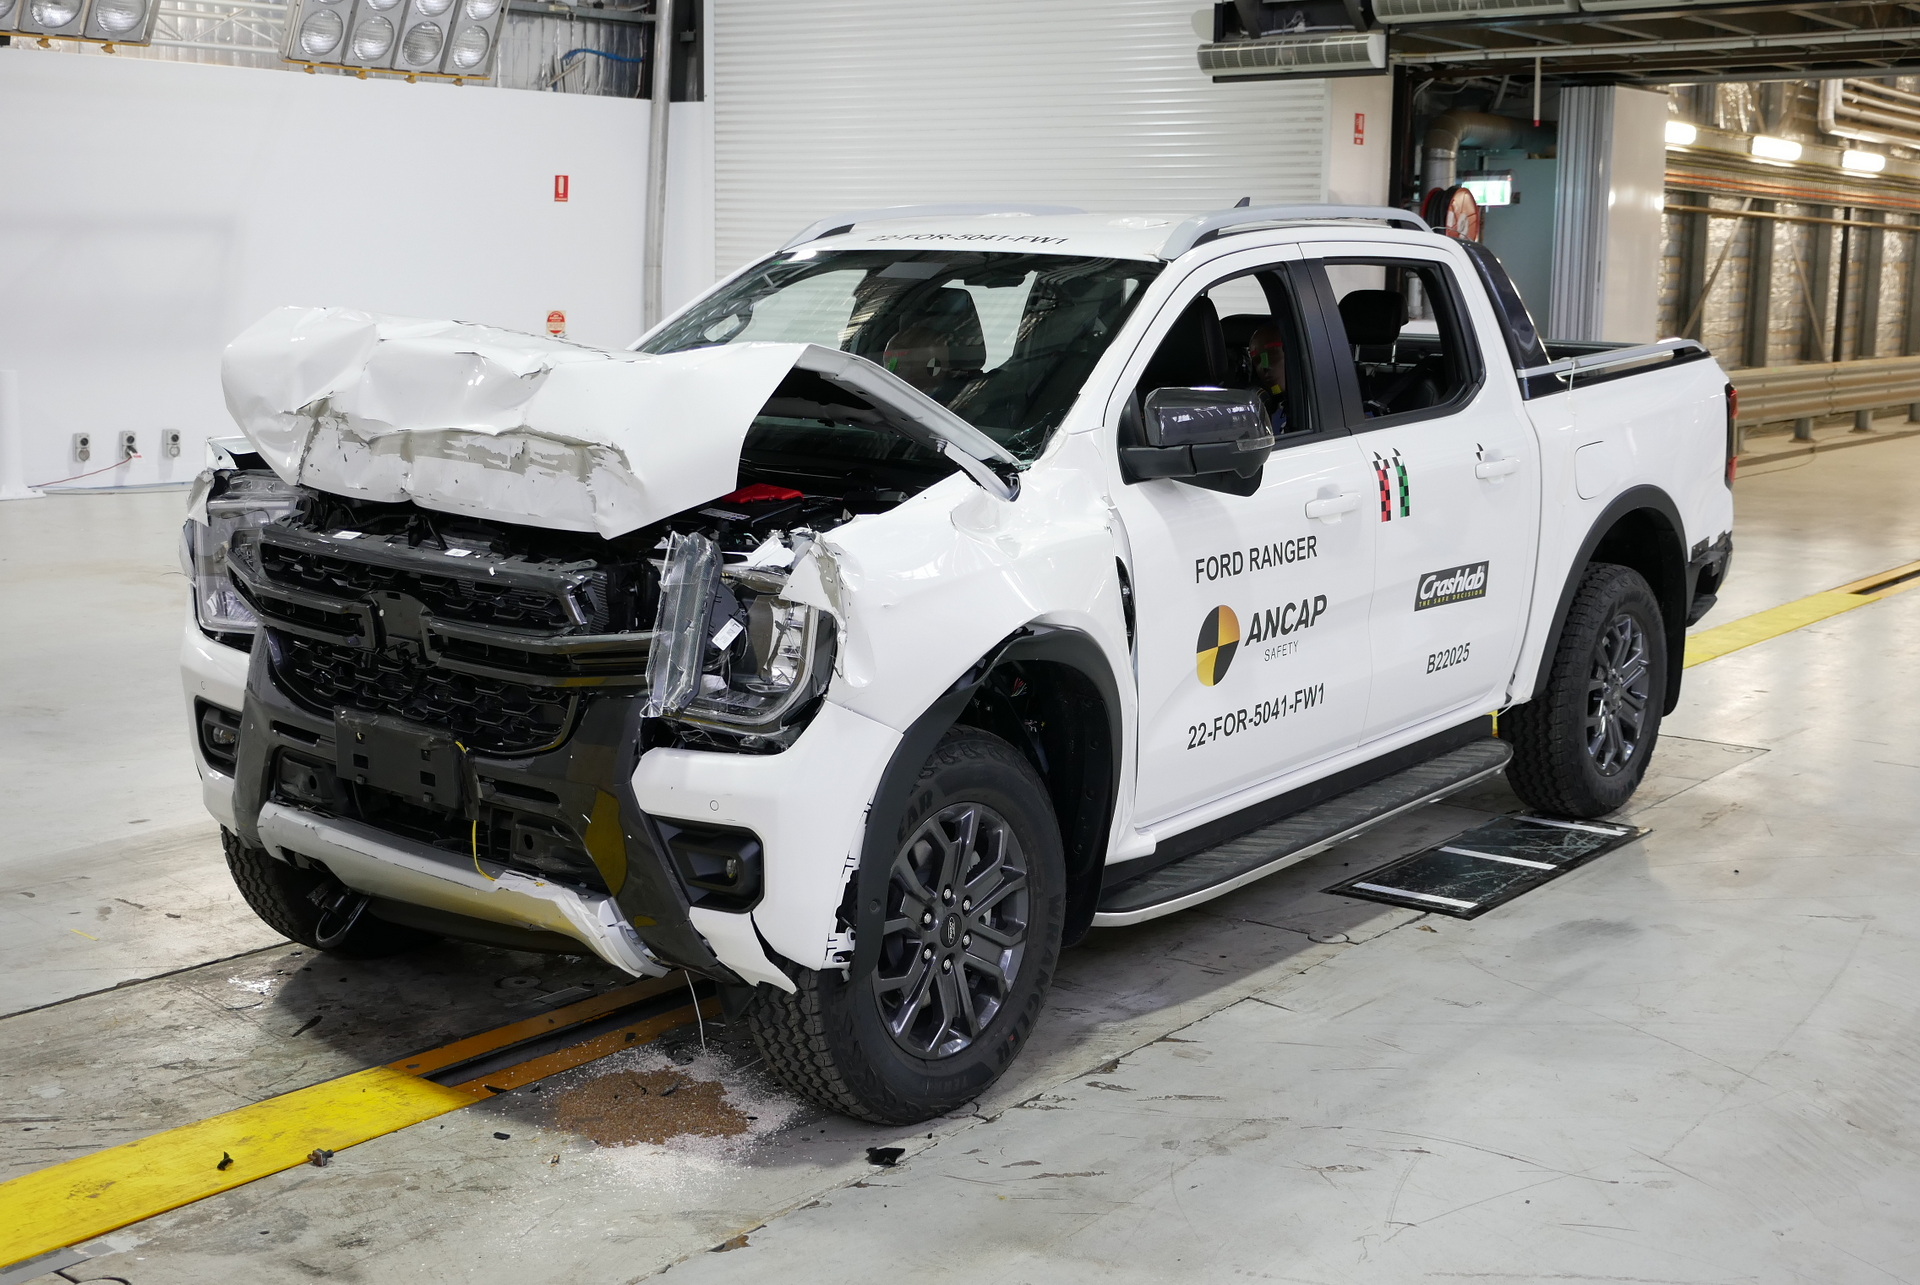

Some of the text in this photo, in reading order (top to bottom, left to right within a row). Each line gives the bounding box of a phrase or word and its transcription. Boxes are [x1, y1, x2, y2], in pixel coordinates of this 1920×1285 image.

[868, 233, 1069, 245] 22-FOR-5041-FW1
[1195, 534, 1318, 584] FORD RANGER
[1418, 589, 1483, 608] THE SAFE DECISION
[1420, 565, 1485, 600] Crashlab
[1244, 594, 1328, 647] ANCAP
[1263, 639, 1299, 662] SAFETY
[1426, 642, 1471, 675] B22025
[1186, 682, 1325, 751] 22-FOR-5041-FW1
